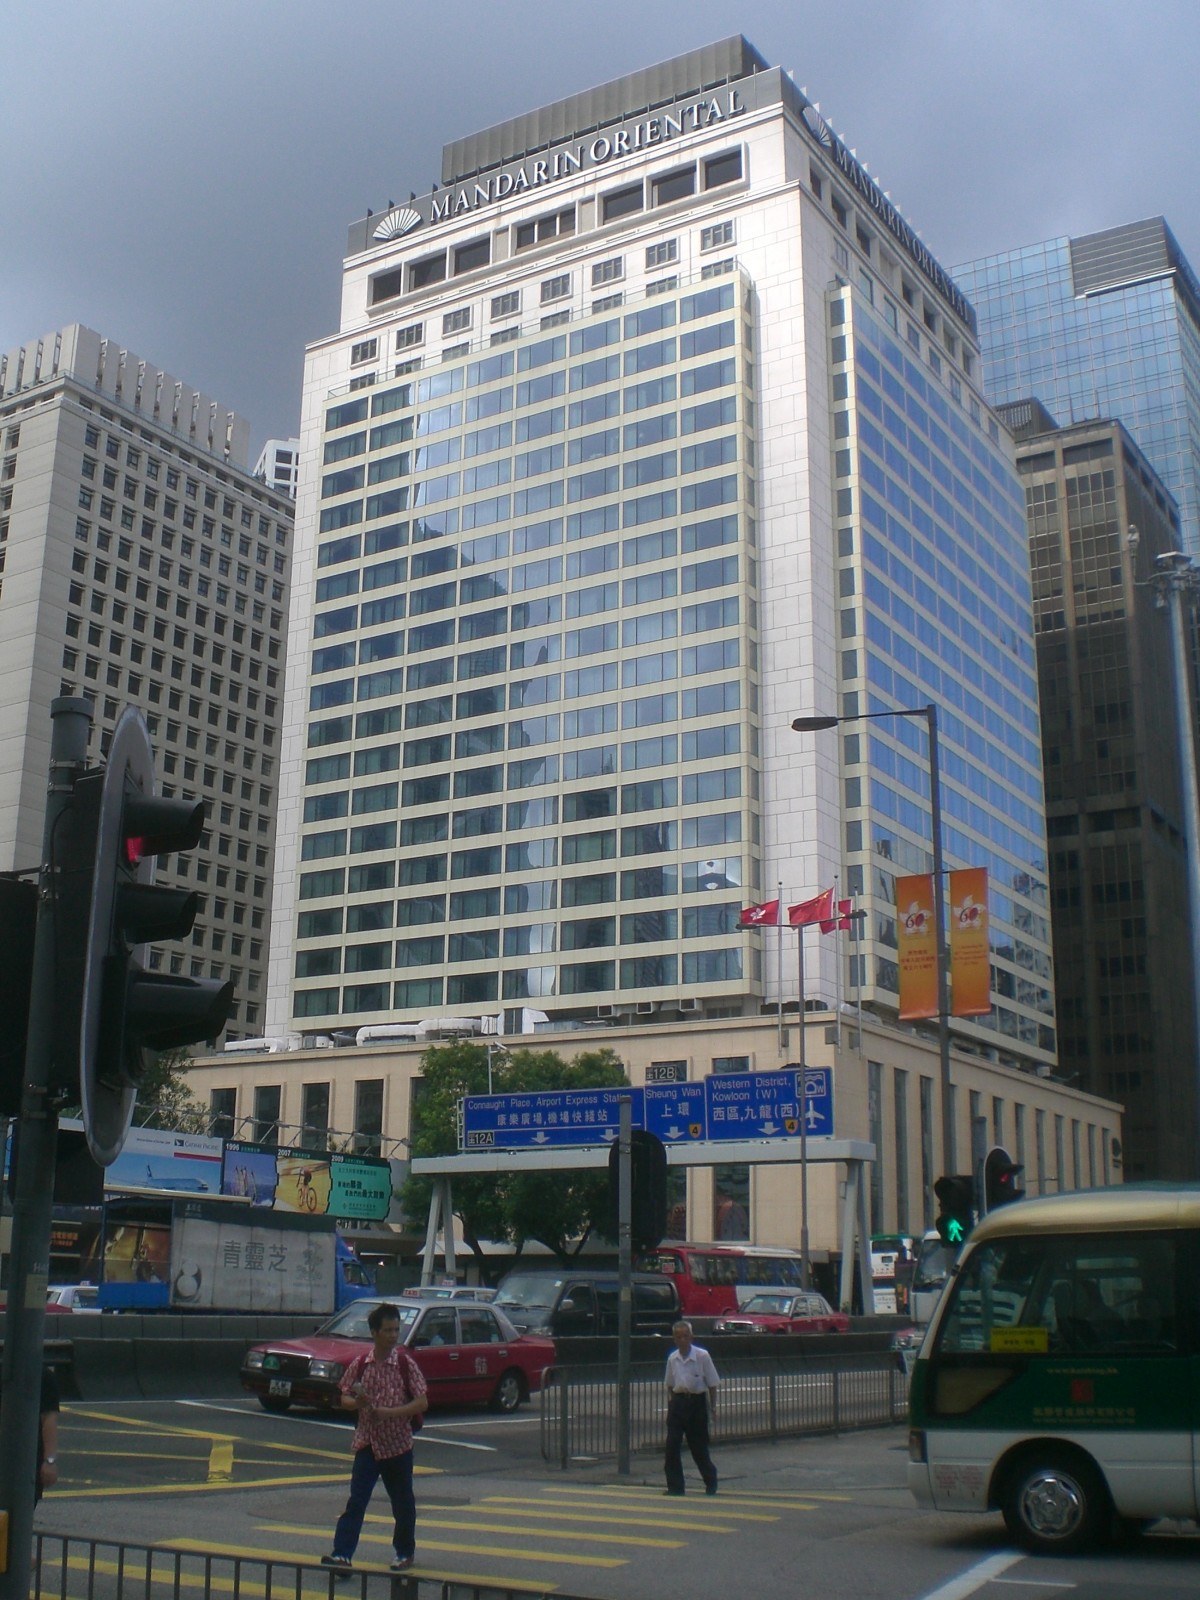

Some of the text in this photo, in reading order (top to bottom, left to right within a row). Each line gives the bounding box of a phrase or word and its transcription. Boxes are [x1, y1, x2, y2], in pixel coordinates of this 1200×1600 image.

[430, 90, 746, 222] MANDARIN ORIENTAL
[836, 141, 911, 249] MANDARIN
[654, 1067, 675, 1079] 12B
[712, 1080, 750, 1090] Western
[646, 1087, 701, 1099] Sheung Wan
[712, 1091, 750, 1102] Kowloon
[468, 1100, 505, 1110] Connaught
[536, 1096, 562, 1107] Airport
[566, 1095, 598, 1106] Express
[661, 1102, 689, 1118] 上環
[475, 1132, 493, 1144] 12A
[278, 1148, 291, 1157] 2007
[223, 1240, 288, 1272] 青靈芝
